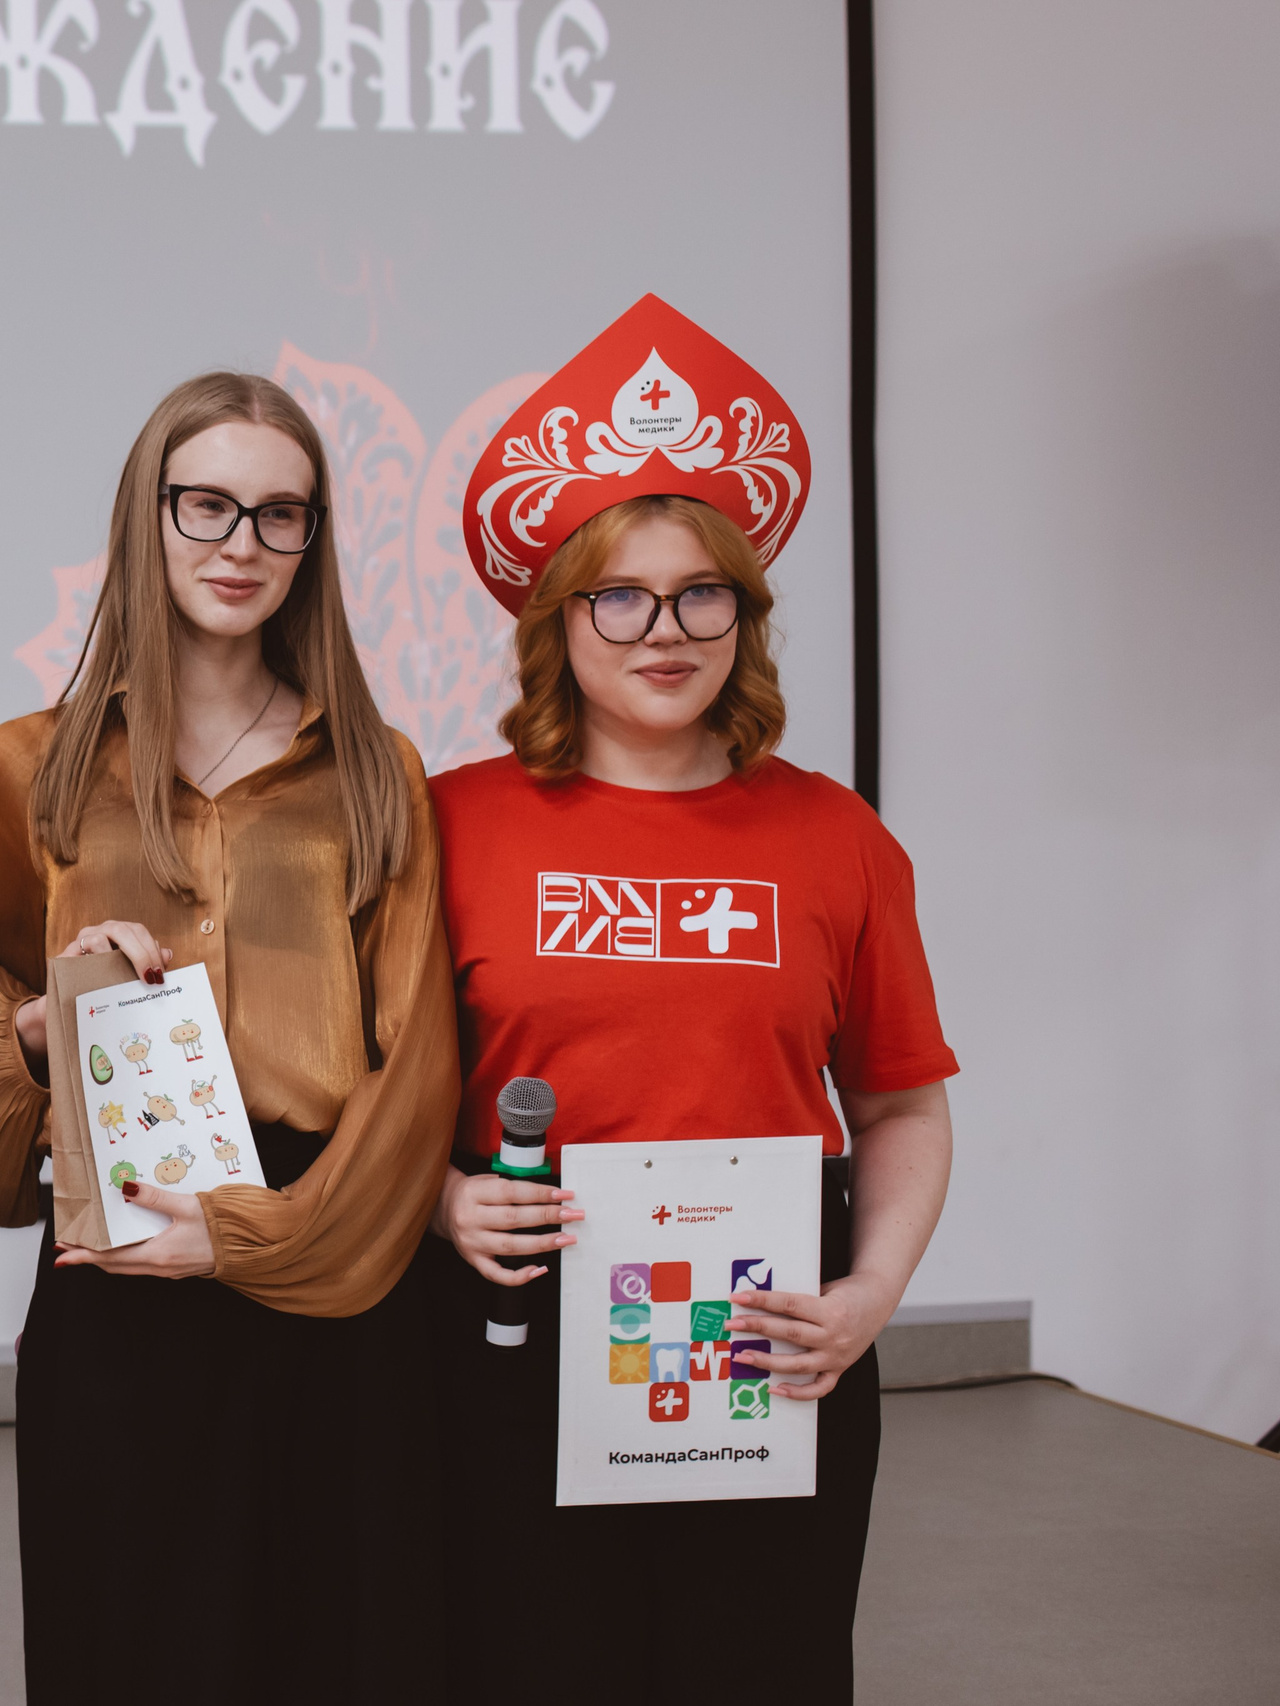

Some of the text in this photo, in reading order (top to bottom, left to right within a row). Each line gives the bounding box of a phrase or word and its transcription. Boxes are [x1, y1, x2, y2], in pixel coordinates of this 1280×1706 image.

[629, 416, 682, 426] Волонтеры
[638, 426, 675, 434] медики
[117, 986, 183, 1008] КомандаСанПроф
[677, 1204, 733, 1215] Волонтеры
[677, 1215, 716, 1224] медики
[609, 1445, 770, 1465] КомандаСанПроф
